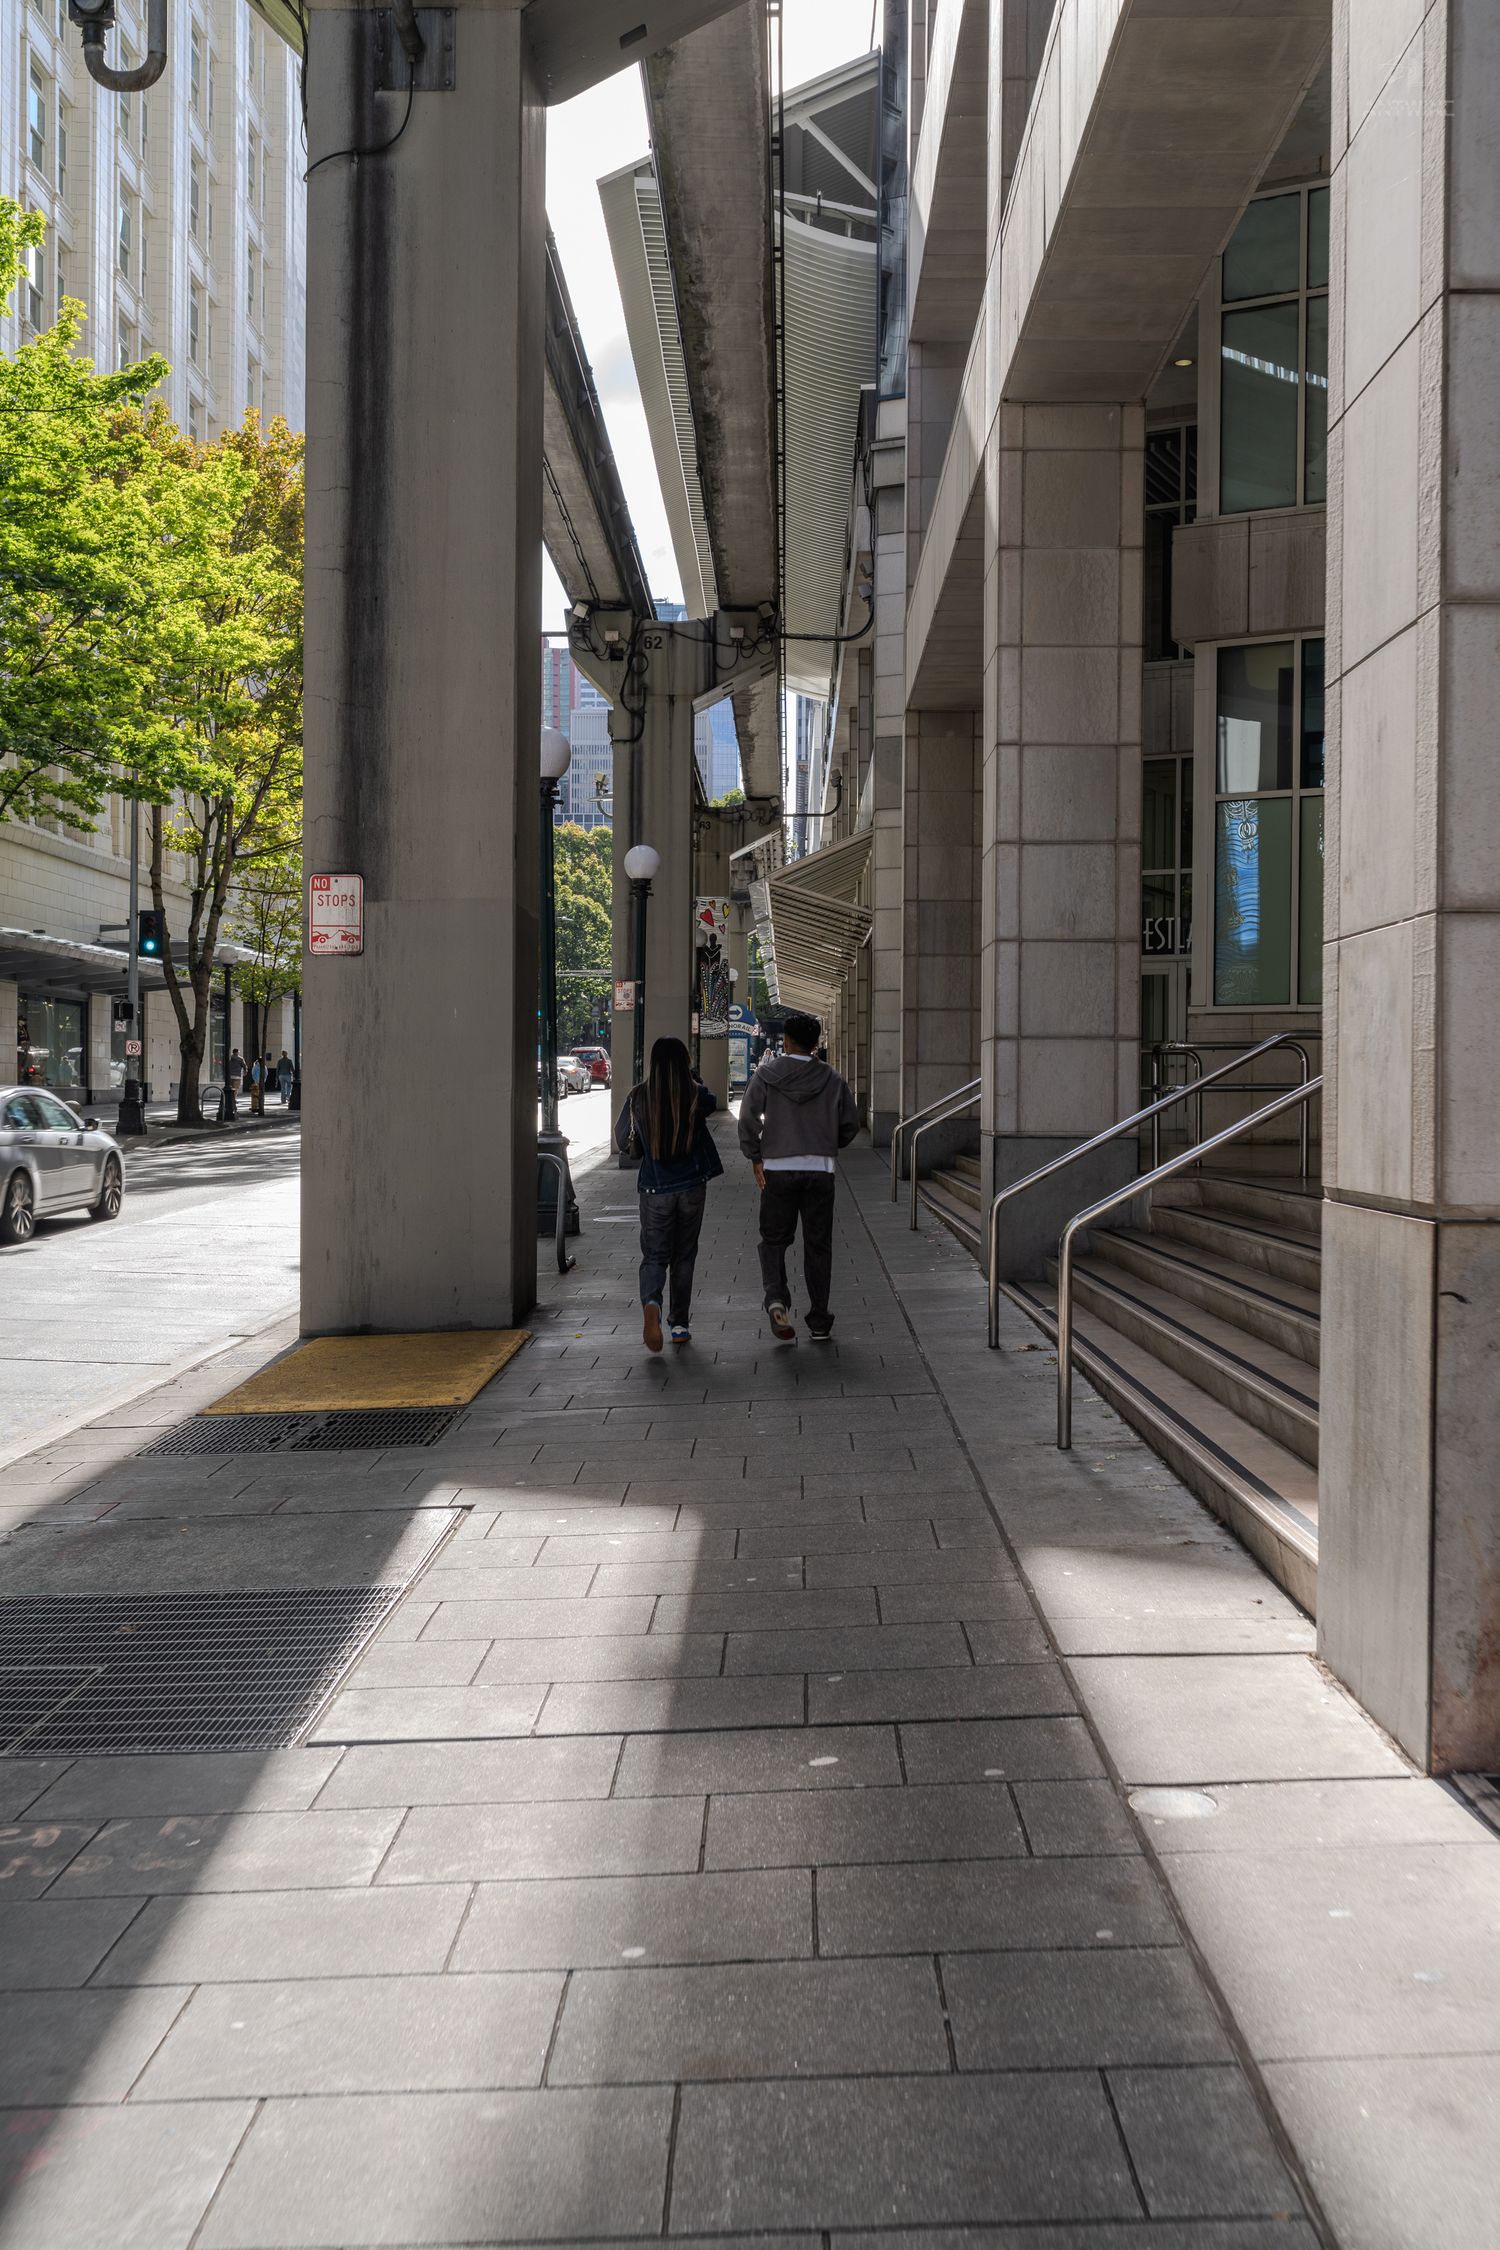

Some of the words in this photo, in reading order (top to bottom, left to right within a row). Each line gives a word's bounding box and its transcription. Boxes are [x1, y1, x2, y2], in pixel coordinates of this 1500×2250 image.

[644, 636, 663, 649] 62
[314, 878, 328, 889] NO
[317, 894, 356, 907] STOPS
